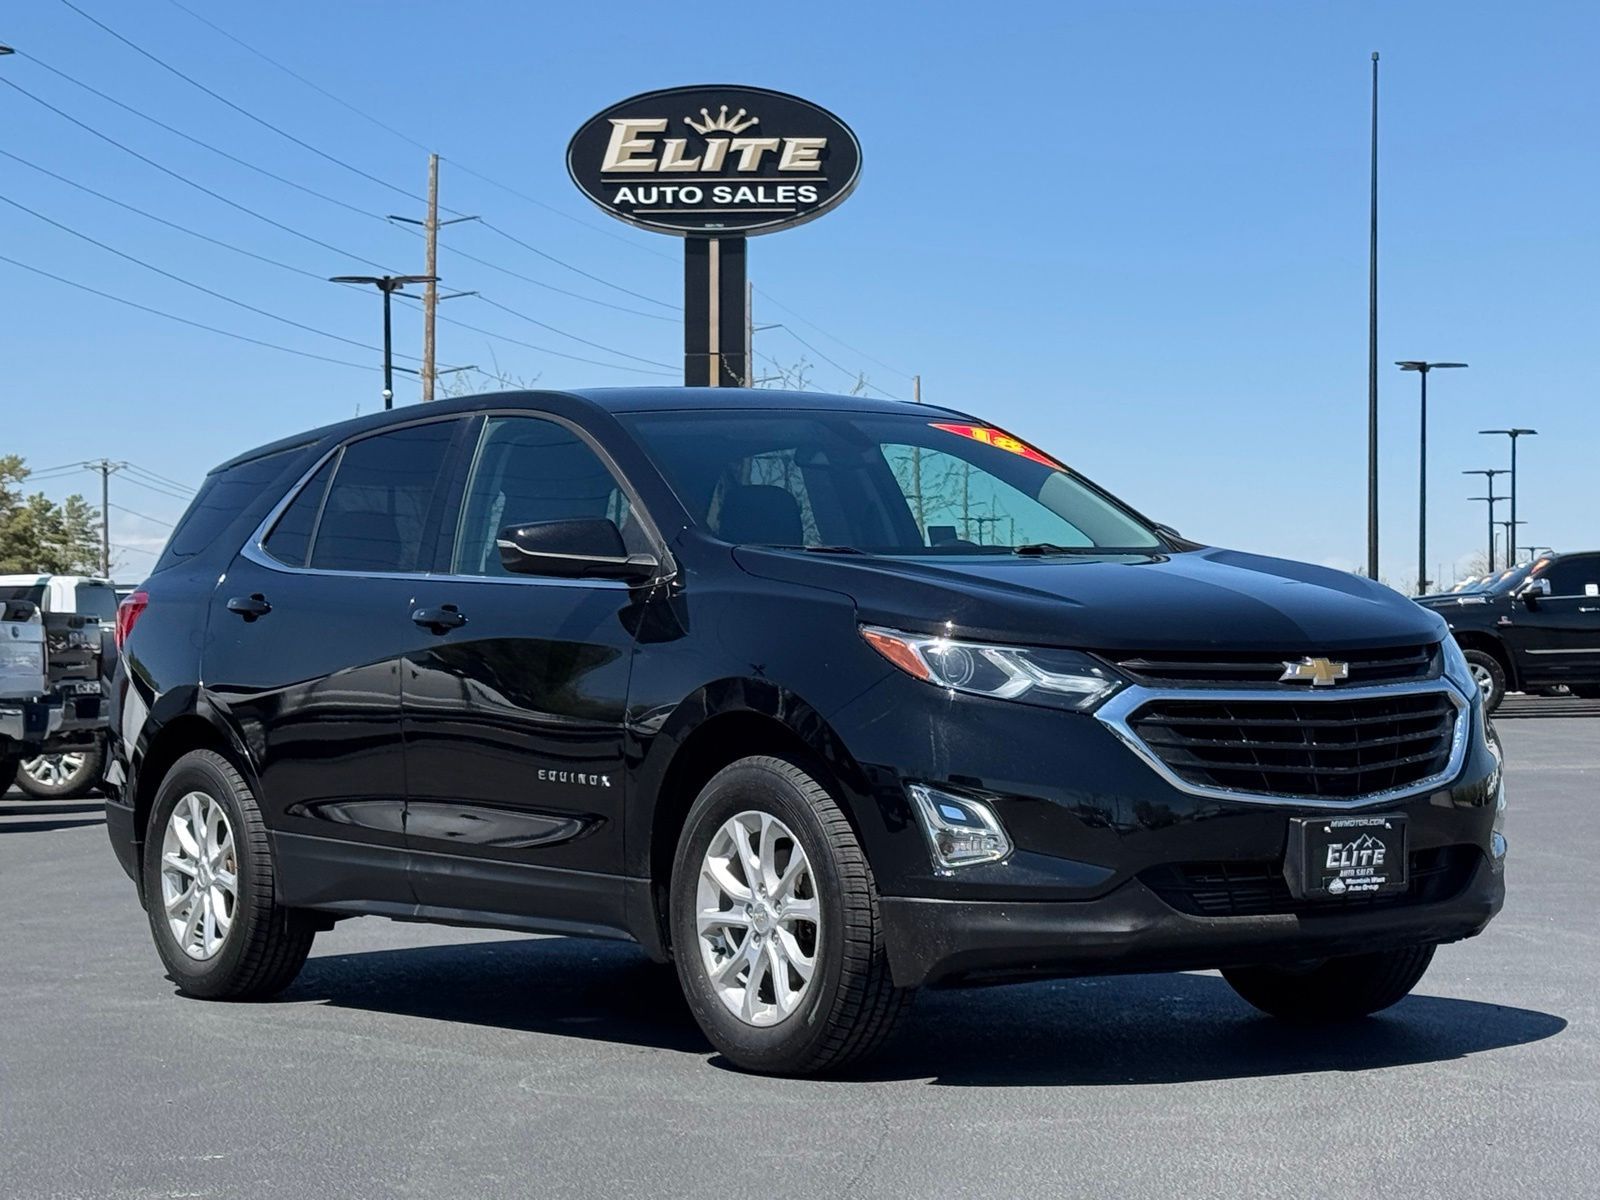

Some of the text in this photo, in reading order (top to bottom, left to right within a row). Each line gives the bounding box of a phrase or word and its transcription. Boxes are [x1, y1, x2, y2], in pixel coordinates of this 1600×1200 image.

[600, 118, 827, 172] ELITE
[613, 185, 818, 204] AUTO SALES
[971, 427, 1025, 453] 18
[537, 769, 611, 788] EQUINOX
[1326, 844, 1386, 868] ELITE
[1339, 867, 1375, 877] AUTO SALES
